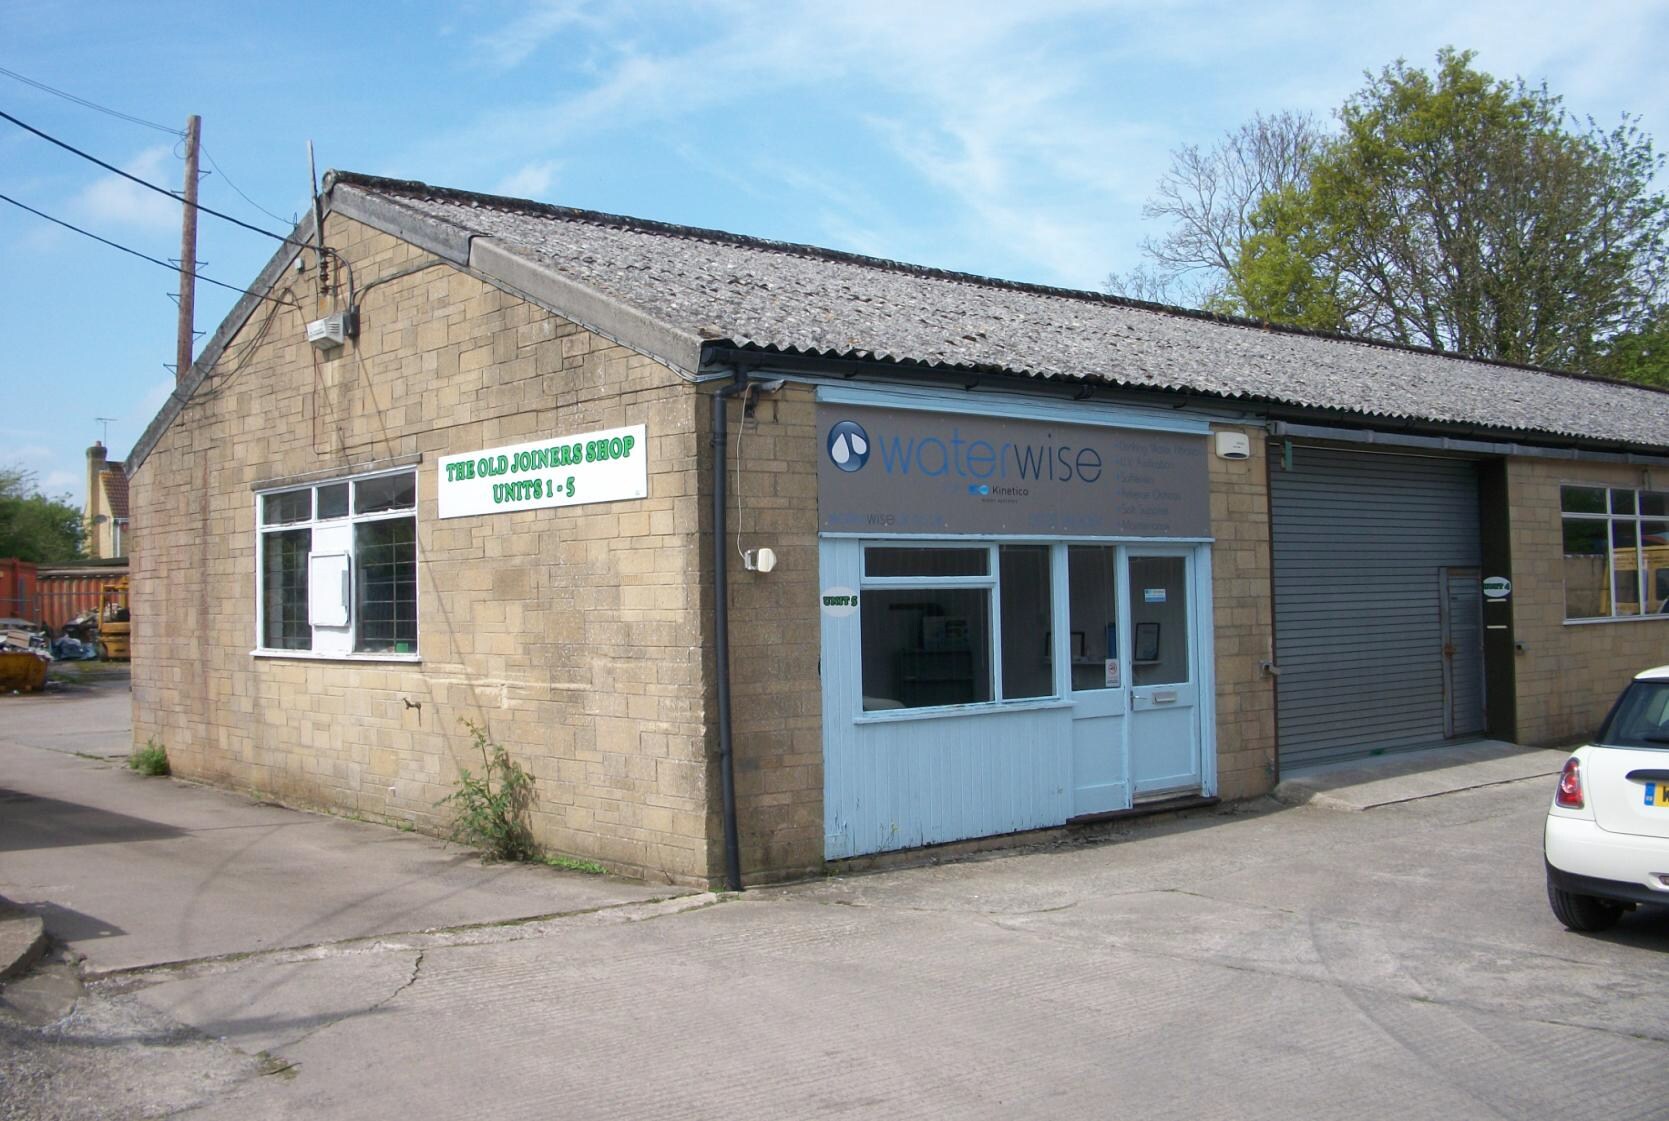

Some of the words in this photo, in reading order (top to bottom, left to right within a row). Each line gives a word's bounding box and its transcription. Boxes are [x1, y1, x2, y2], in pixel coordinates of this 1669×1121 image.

[446, 460, 475, 482] THE
[477, 455, 508, 477] OLD
[510, 443, 583, 473] JOINERS
[585, 435, 635, 463] SHOP
[878, 427, 1102, 483] waterwise
[492, 479, 543, 504] UNITS
[546, 479, 554, 497] 1
[566, 476, 576, 497] 5
[992, 484, 1029, 497] Kinetico
[823, 595, 850, 606] UNIT
[851, 595, 858, 607] 5
